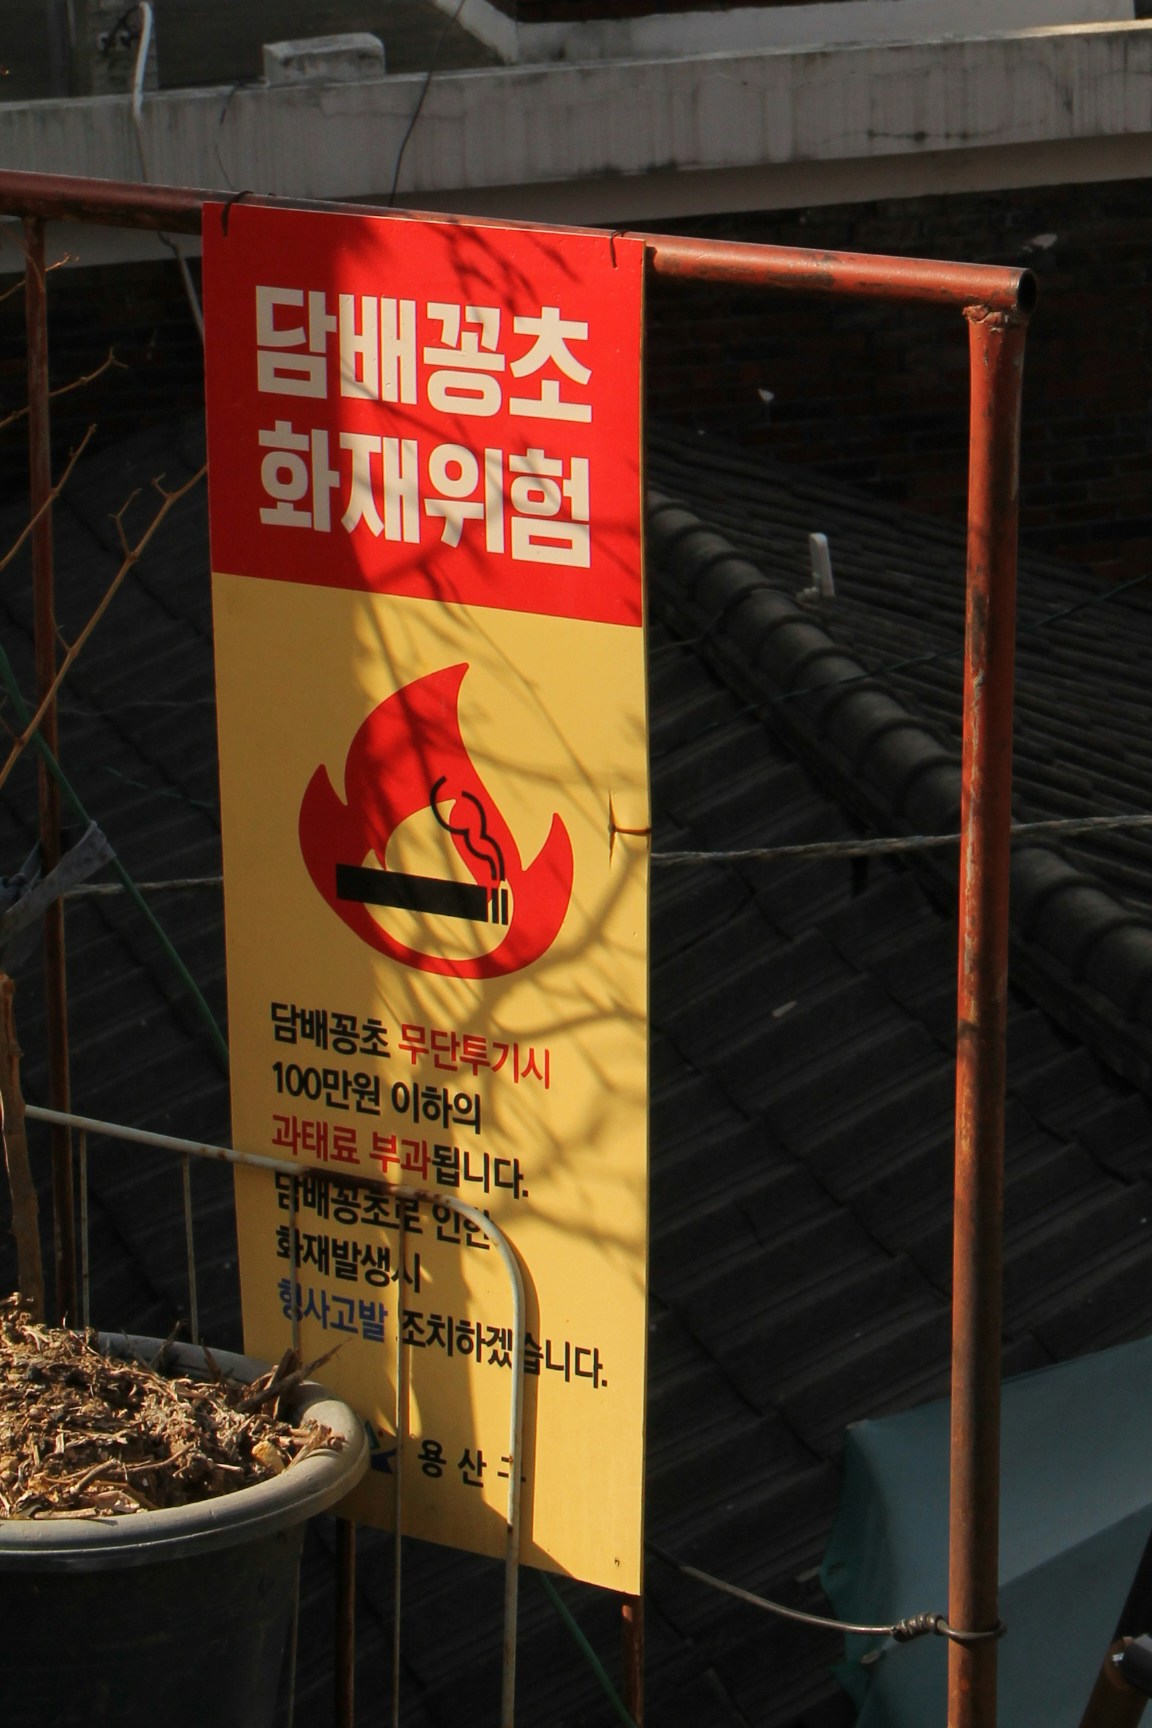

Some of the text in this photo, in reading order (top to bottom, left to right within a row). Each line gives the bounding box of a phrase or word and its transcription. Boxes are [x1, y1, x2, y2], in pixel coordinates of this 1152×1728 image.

[255, 285, 593, 423] 담배꽁초
[258, 420, 591, 568] 화재위험
[271, 1002, 550, 1089] 담배꽁초 무단투기시
[272, 1062, 481, 1134] 100만원 이하의
[272, 1114, 360, 1165] 과태료
[278, 1278, 388, 1343] 형사고발
